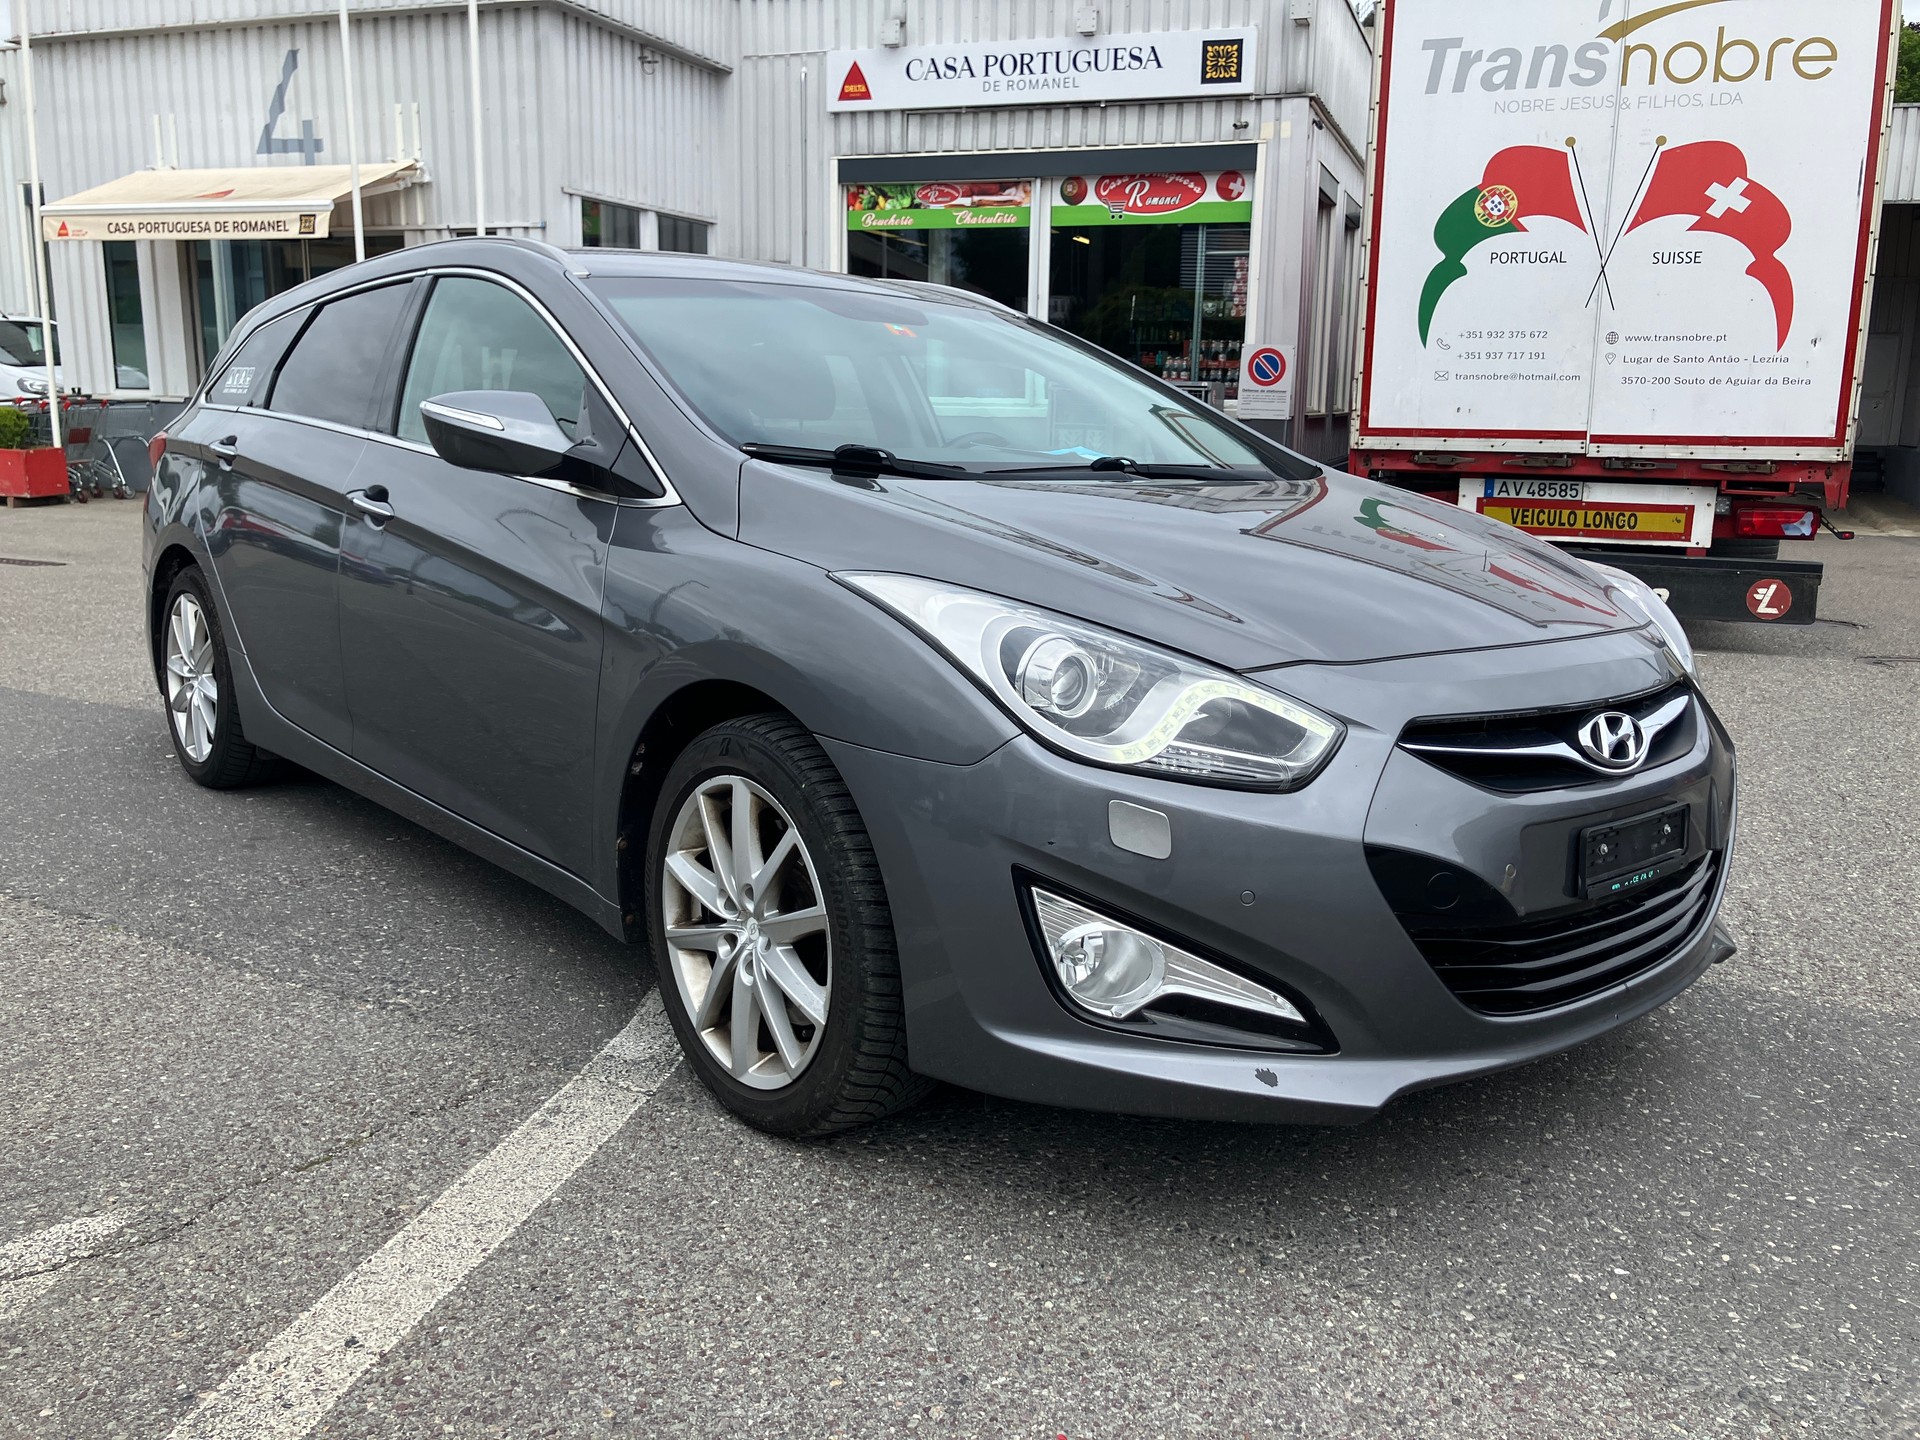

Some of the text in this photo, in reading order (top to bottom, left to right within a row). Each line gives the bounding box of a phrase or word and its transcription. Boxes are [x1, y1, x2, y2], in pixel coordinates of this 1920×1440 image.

[905, 45, 1163, 82] CASA PORTUGUESA
[982, 77, 1079, 93] DE ROMANEL
[256, 48, 325, 166] 4
[1494, 92, 1743, 114] NOBRE JESUS & FILHOS, LDA
[862, 210, 1017, 228] Boucherie Charcuterie
[107, 220, 289, 234] CASA PORTUGUESA DE ROMANEL
[1490, 251, 1567, 264] PORTUGAL
[1652, 251, 1703, 265] SUISSE
[1458, 330, 1548, 339] +351 932 375 672
[1625, 333, 1727, 343] www.transnobre.pt
[1456, 351, 1546, 360] +351 937 717 191
[1623, 355, 1653, 365] Lugar
[1656, 355, 1670, 364] de
[1673, 355, 1705, 364] Santo
[1708, 355, 1740, 364] Antão
[1752, 355, 1789, 364] Lezíria
[1455, 372, 1581, 382] transnobre@hotmail.com
[1621, 376, 1811, 387] 3570-200 Souto de Aguiar da Beira
[1497, 481, 1580, 499] AV48585
[1510, 507, 1638, 530] VEICULO LONGO
